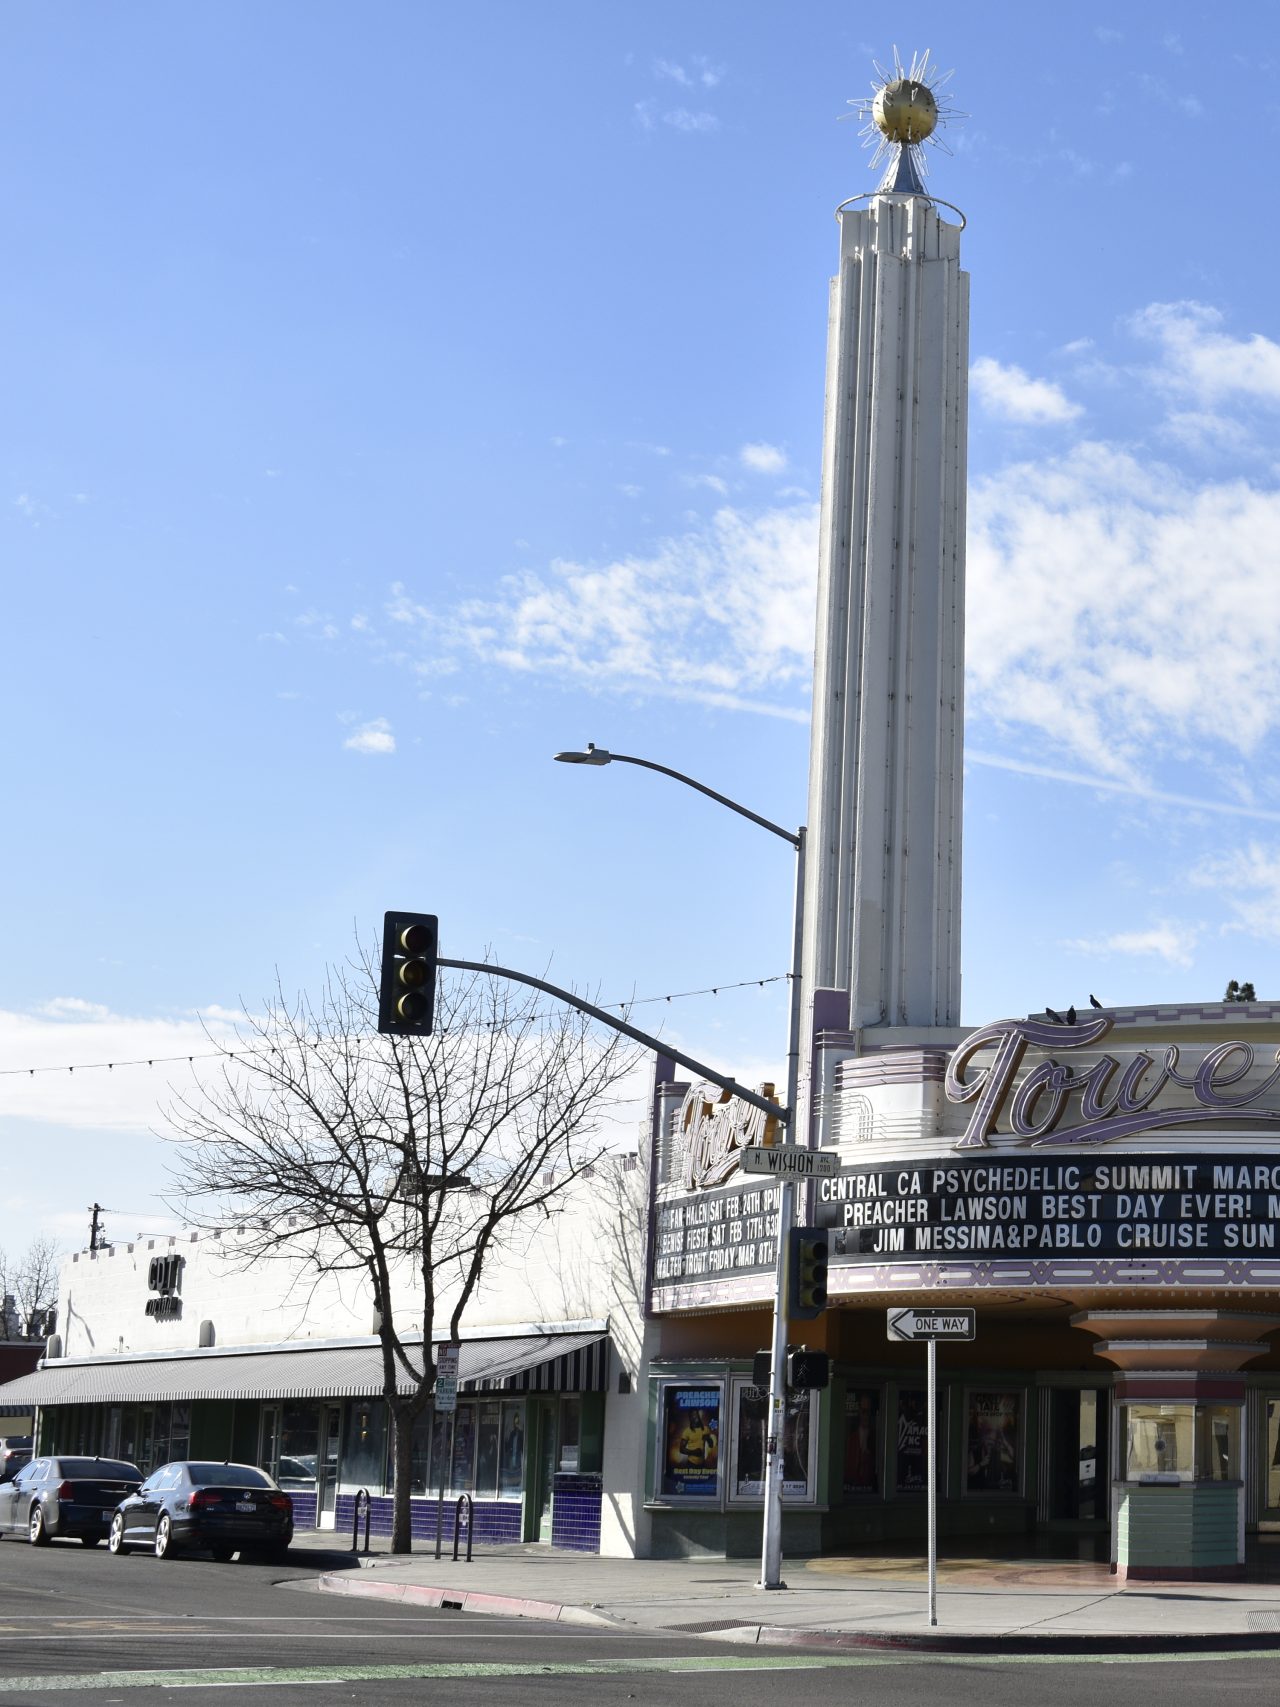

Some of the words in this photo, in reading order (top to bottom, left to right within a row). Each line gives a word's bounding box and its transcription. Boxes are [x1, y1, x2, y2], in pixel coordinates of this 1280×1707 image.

[768, 1152, 814, 1173] WISHON
[821, 1174, 887, 1201] CENTRAL
[898, 1172, 921, 1194] CA
[933, 1166, 1080, 1194] PSYCHEDELIC
[1095, 1165, 1197, 1190] SUMMIT
[686, 1203, 707, 1226] HALEN
[710, 1200, 723, 1221] SAT
[726, 1196, 739, 1218] FEB
[742, 1192, 760, 1216] 24TH
[844, 1199, 928, 1226] PREACHER
[941, 1196, 1027, 1222] LAWSON
[1042, 1194, 1102, 1219] BEST
[1117, 1194, 1163, 1218] DAY
[1180, 1194, 1252, 1218] EVER!
[662, 1231, 684, 1254] DENISE
[686, 1226, 708, 1250] FIESTA
[712, 1224, 726, 1246] SAT
[730, 1220, 742, 1243] FEB
[746, 1217, 764, 1240] 17TH
[873, 1228, 904, 1253] JIM
[915, 1224, 1102, 1250] MESSINA&PABLO
[1117, 1224, 1208, 1248] CRUISE
[1224, 1224, 1275, 1248] SUN
[656, 1256, 682, 1280] WALTER
[685, 1252, 706, 1276] TROUT
[709, 1247, 734, 1271] FRIDAY
[738, 1244, 754, 1266] MAR
[758, 1240, 772, 1264] 8TH
[916, 1318, 938, 1330] ONE
[942, 1318, 966, 1330] WAY
